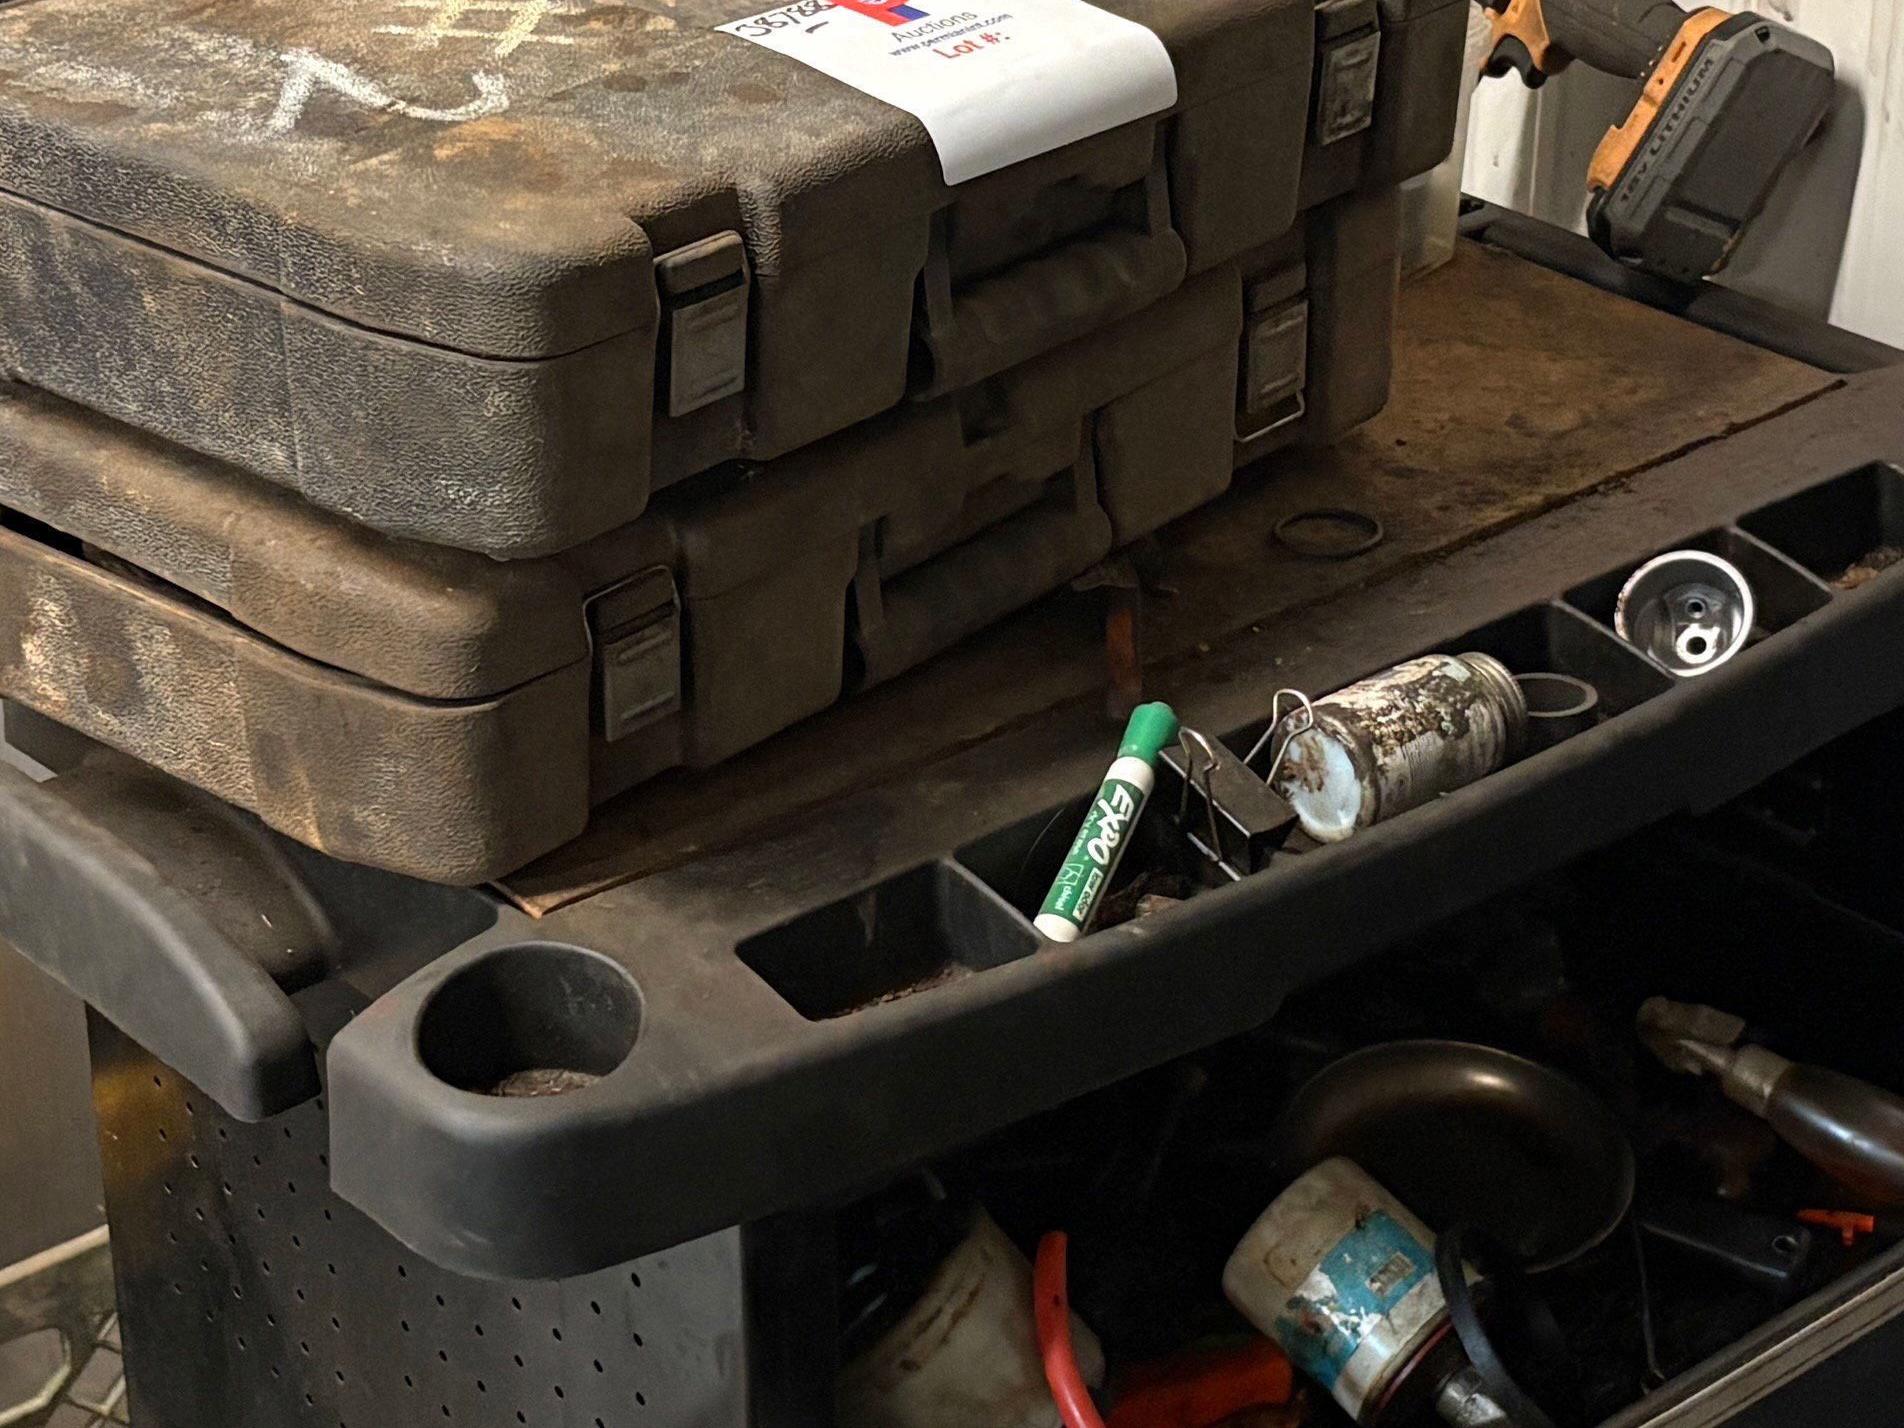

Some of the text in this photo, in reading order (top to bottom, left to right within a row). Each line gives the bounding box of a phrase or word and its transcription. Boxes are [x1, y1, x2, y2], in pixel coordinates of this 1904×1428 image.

[891, 12, 978, 43] Auctions
[932, 39, 984, 59] Lot
[1649, 57, 1715, 159] LITHIUM
[1087, 782, 1135, 866] EXPO
